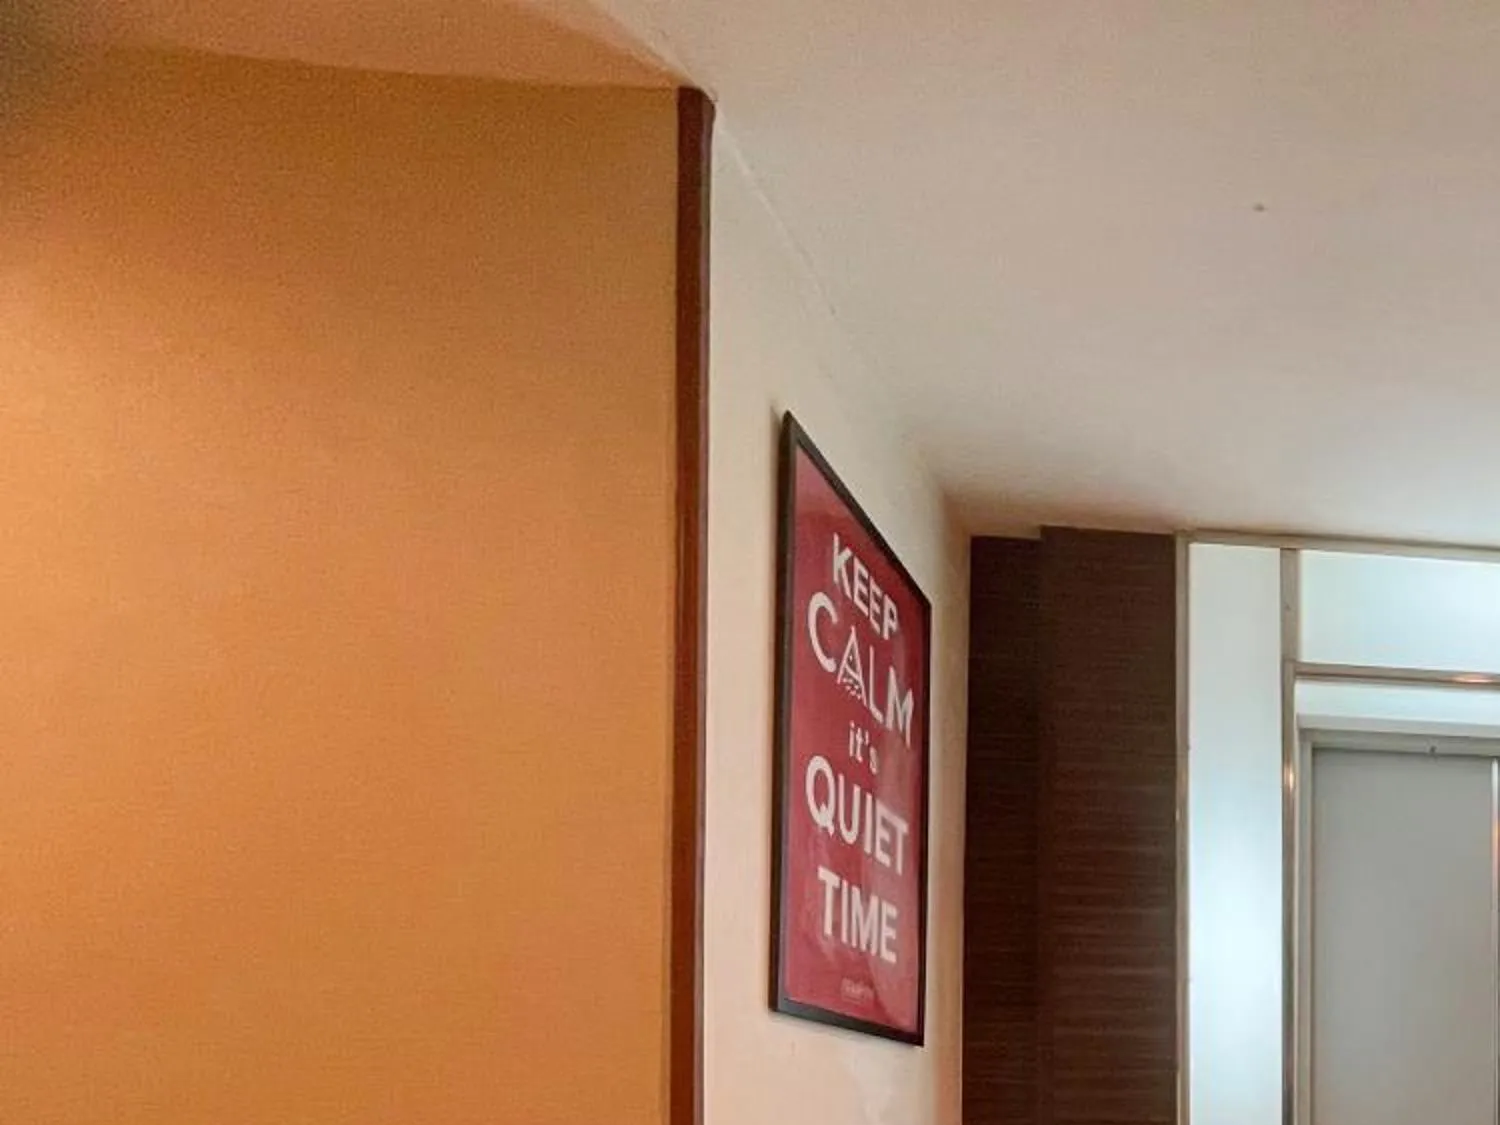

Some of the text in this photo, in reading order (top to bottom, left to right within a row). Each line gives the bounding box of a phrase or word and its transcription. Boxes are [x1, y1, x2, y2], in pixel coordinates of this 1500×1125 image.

[833, 532, 898, 640] KEEP
[808, 591, 914, 748] CALM
[849, 720, 878, 775] it's
[805, 755, 908, 876] QUIET
[818, 865, 898, 963] TIME
